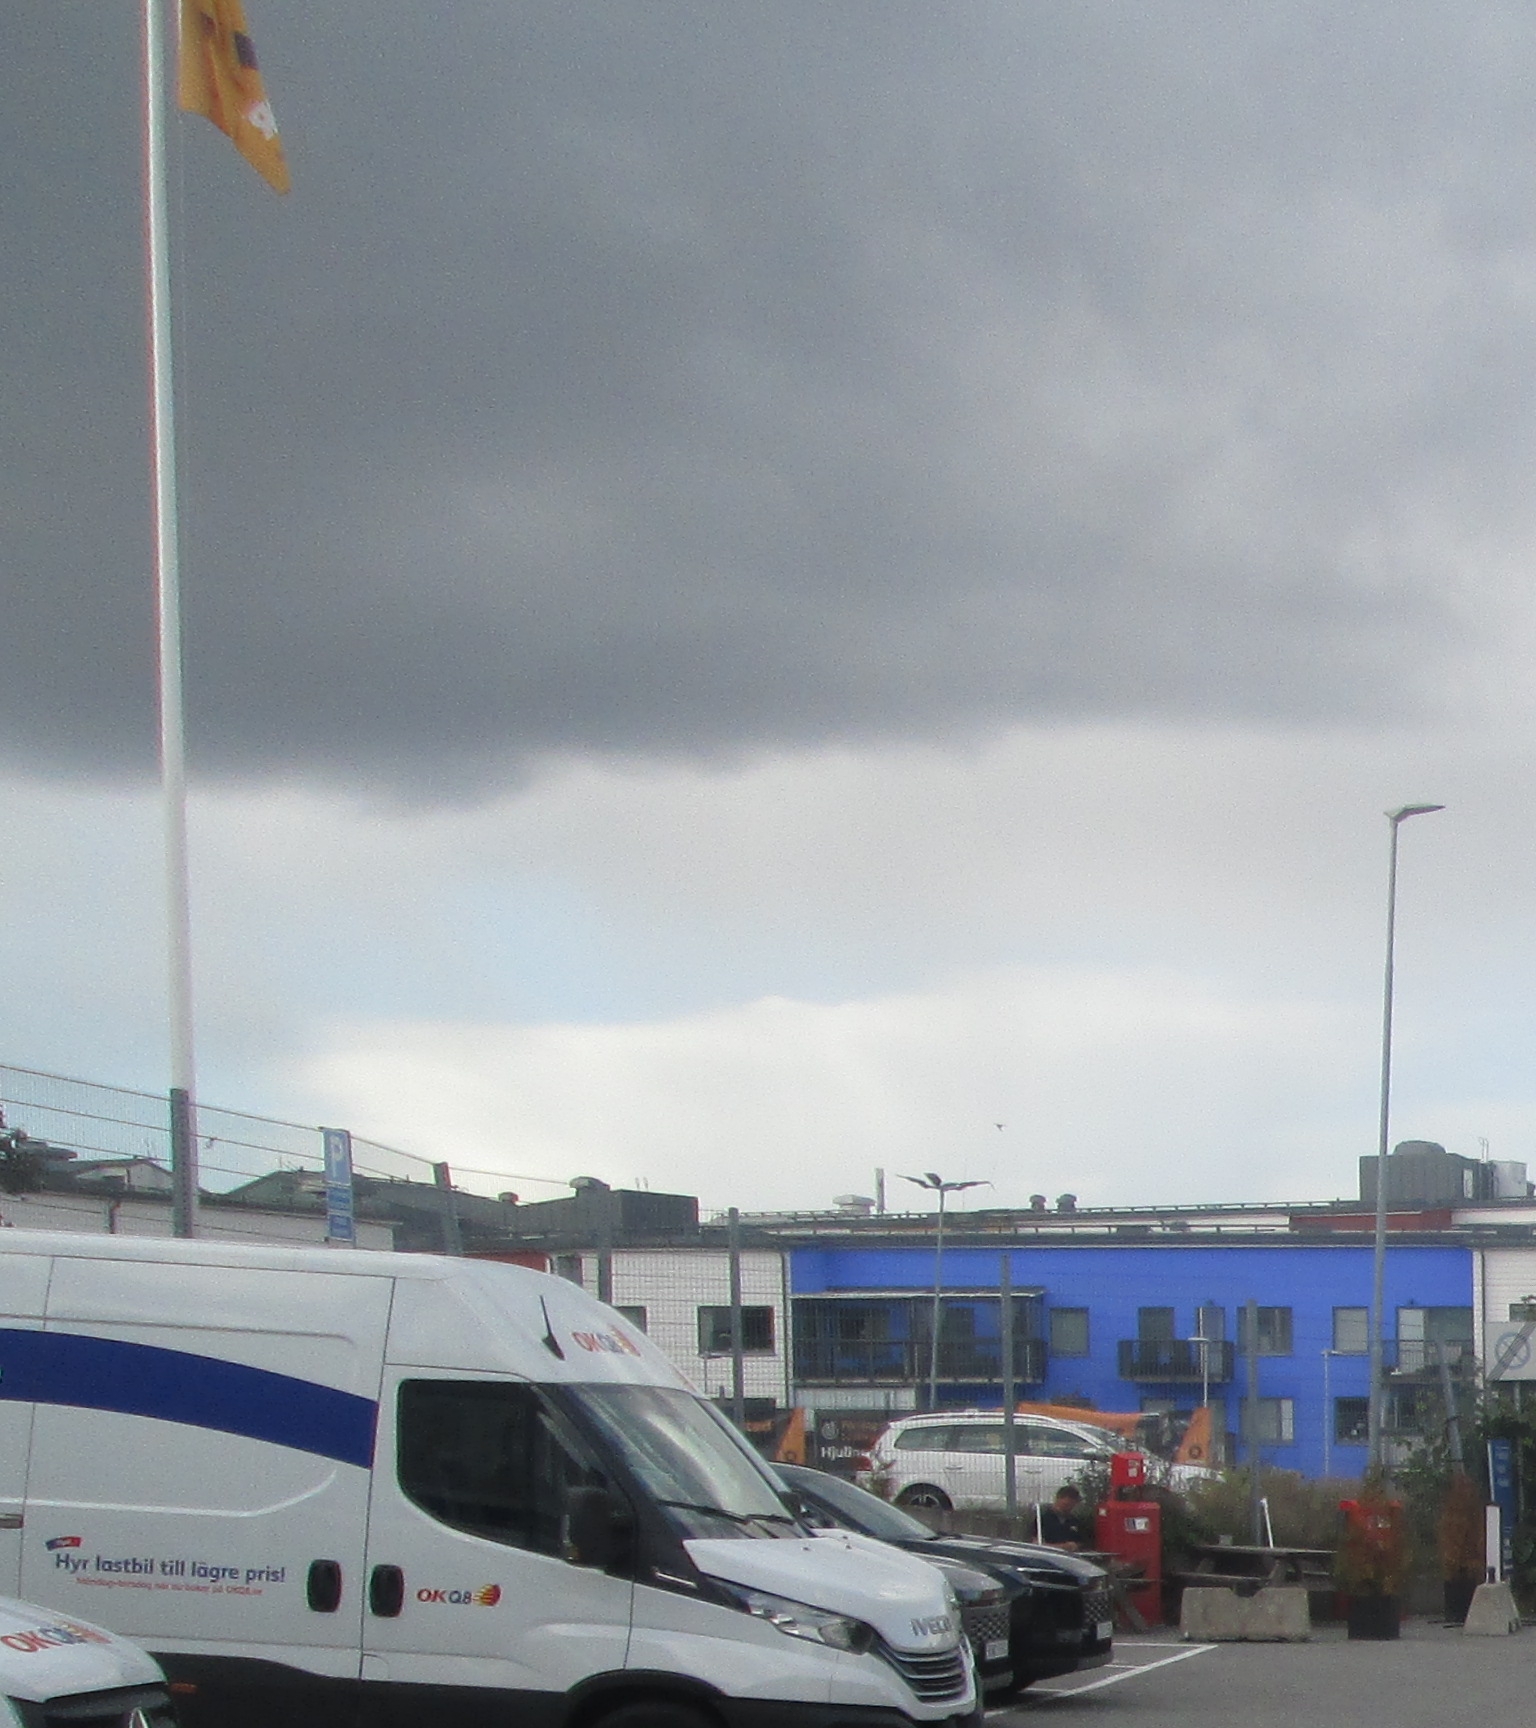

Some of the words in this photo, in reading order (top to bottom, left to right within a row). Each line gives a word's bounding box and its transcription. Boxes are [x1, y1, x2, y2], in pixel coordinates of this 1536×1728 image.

[55, 1554, 89, 1574] Hyr
[96, 1555, 154, 1575] lastbil
[160, 1558, 185, 1577] till
[191, 1561, 239, 1584] lägre
[245, 1566, 286, 1584] pris!
